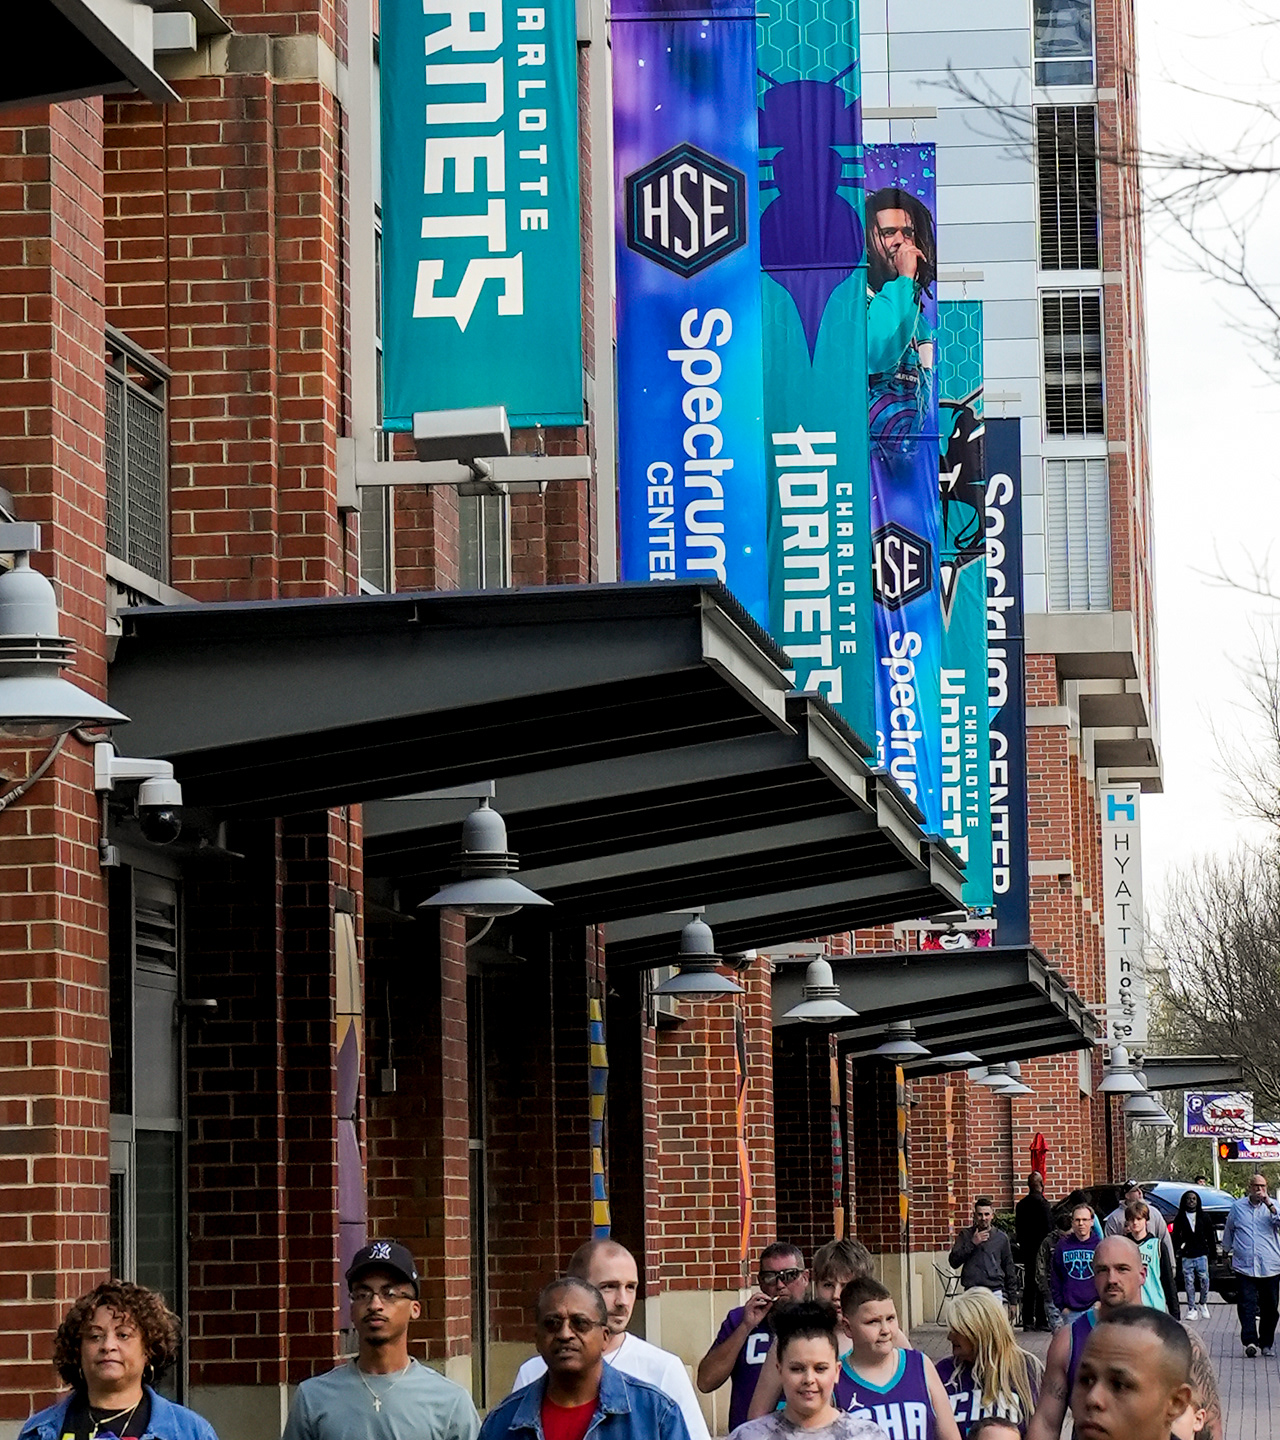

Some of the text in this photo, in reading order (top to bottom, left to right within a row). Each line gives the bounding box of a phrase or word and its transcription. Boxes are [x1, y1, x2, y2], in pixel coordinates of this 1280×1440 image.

[642, 163, 729, 259] HSE
[667, 308, 734, 584] Spectrum
[837, 482, 857, 654] CHARLOTTE
[964, 705, 979, 828] CHARLOTTE
[1114, 833, 1132, 945] HYATT
[1210, 1108, 1246, 1119] LAZ
[1063, 1250, 1095, 1262] HORNET
